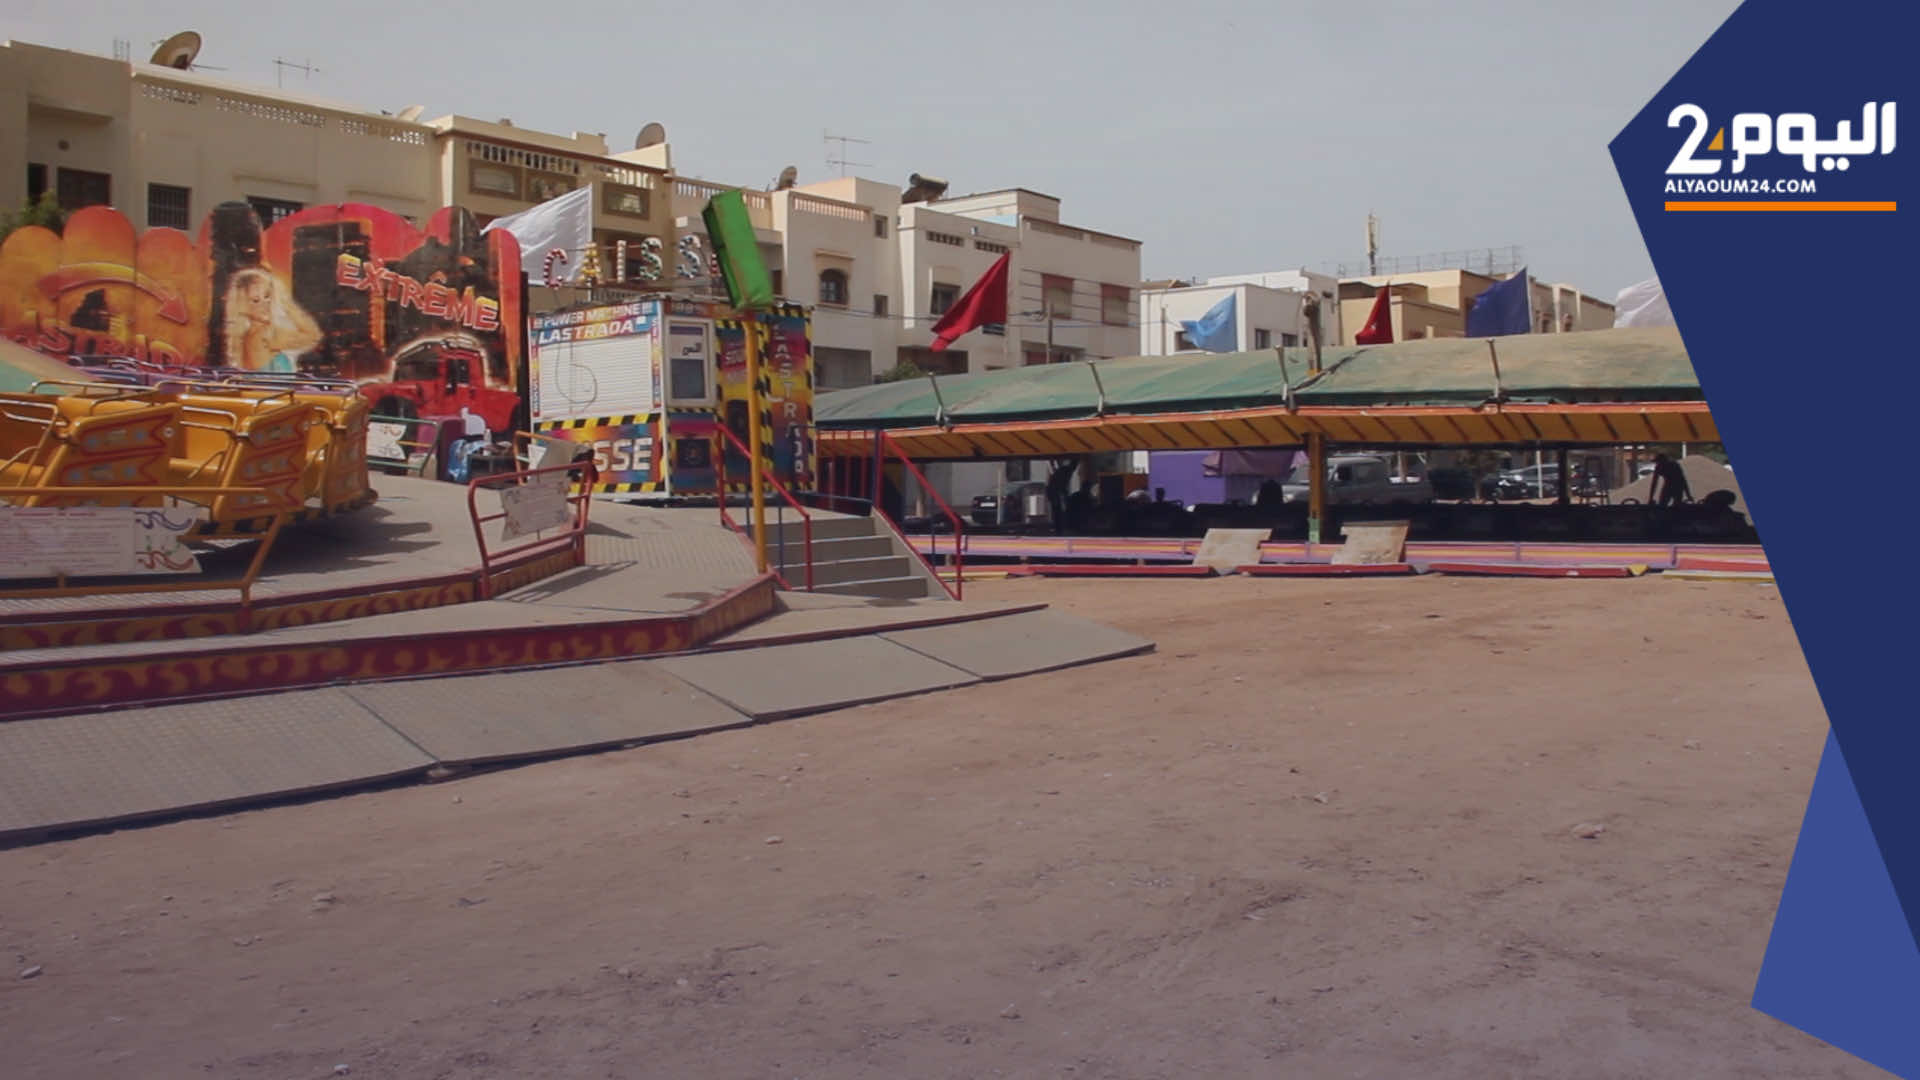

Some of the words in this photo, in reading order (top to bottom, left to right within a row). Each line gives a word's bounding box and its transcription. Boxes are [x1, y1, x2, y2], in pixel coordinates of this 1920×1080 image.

[543, 234, 720, 290] CAISS
[337, 253, 499, 331] EXTRÊME
[539, 319, 634, 344] LASTRADA
[592, 437, 653, 473] SSE
